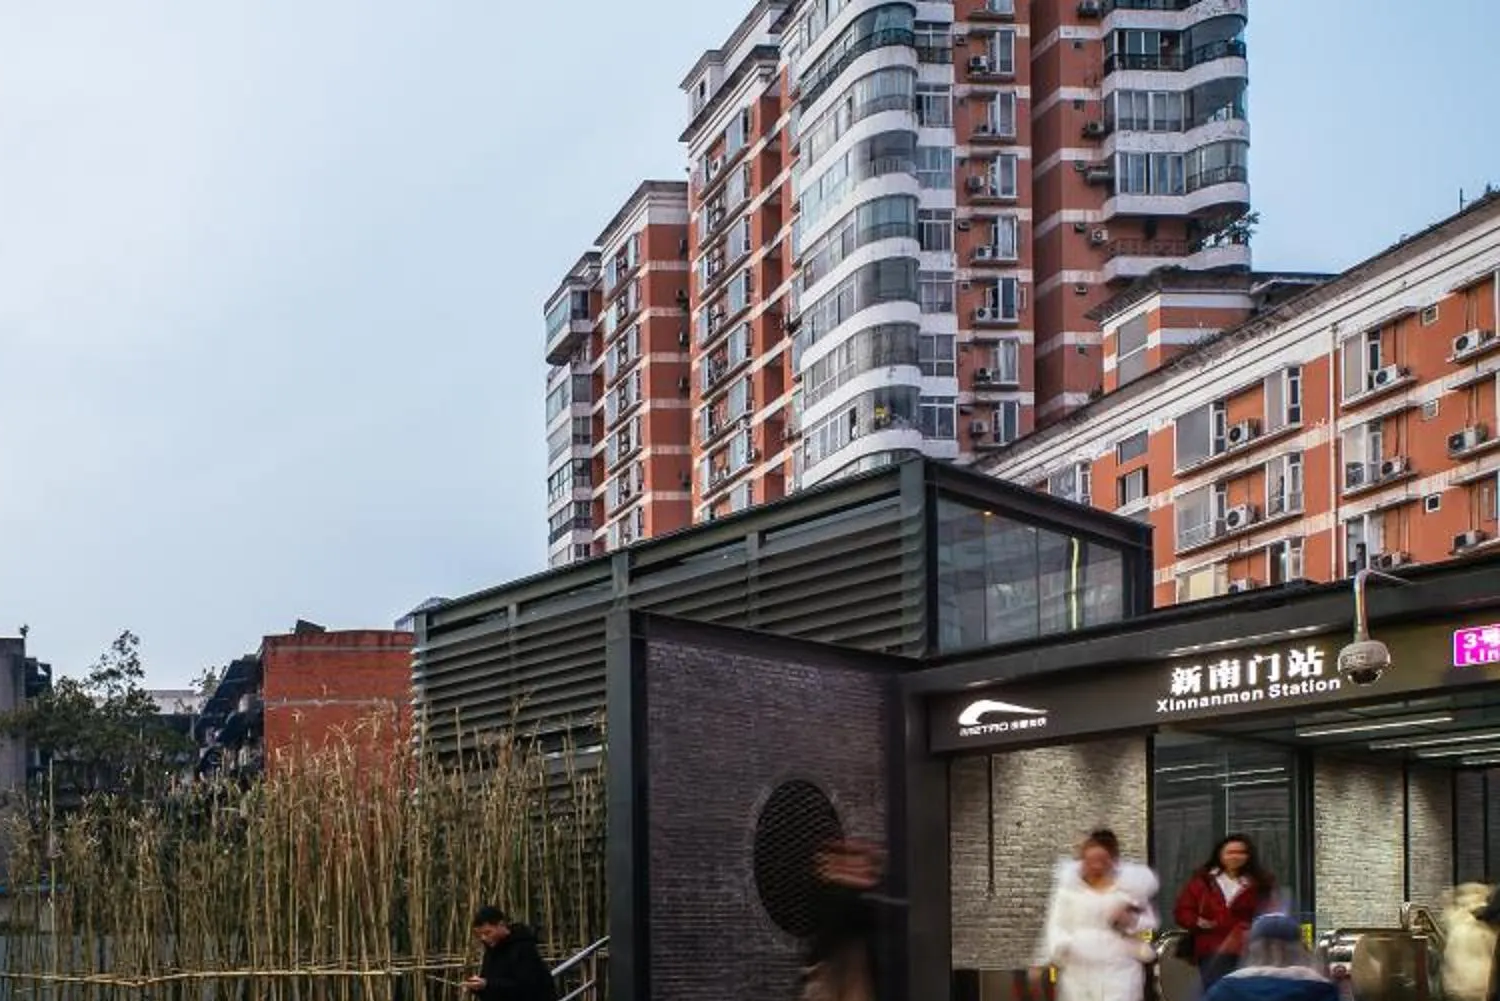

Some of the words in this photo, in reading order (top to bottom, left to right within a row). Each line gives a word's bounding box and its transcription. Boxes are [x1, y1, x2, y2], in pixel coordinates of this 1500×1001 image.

[1170, 645, 1325, 696] 新南门站
[1155, 687, 1265, 713] Xinnanmon
[1268, 677, 1342, 699] Station
